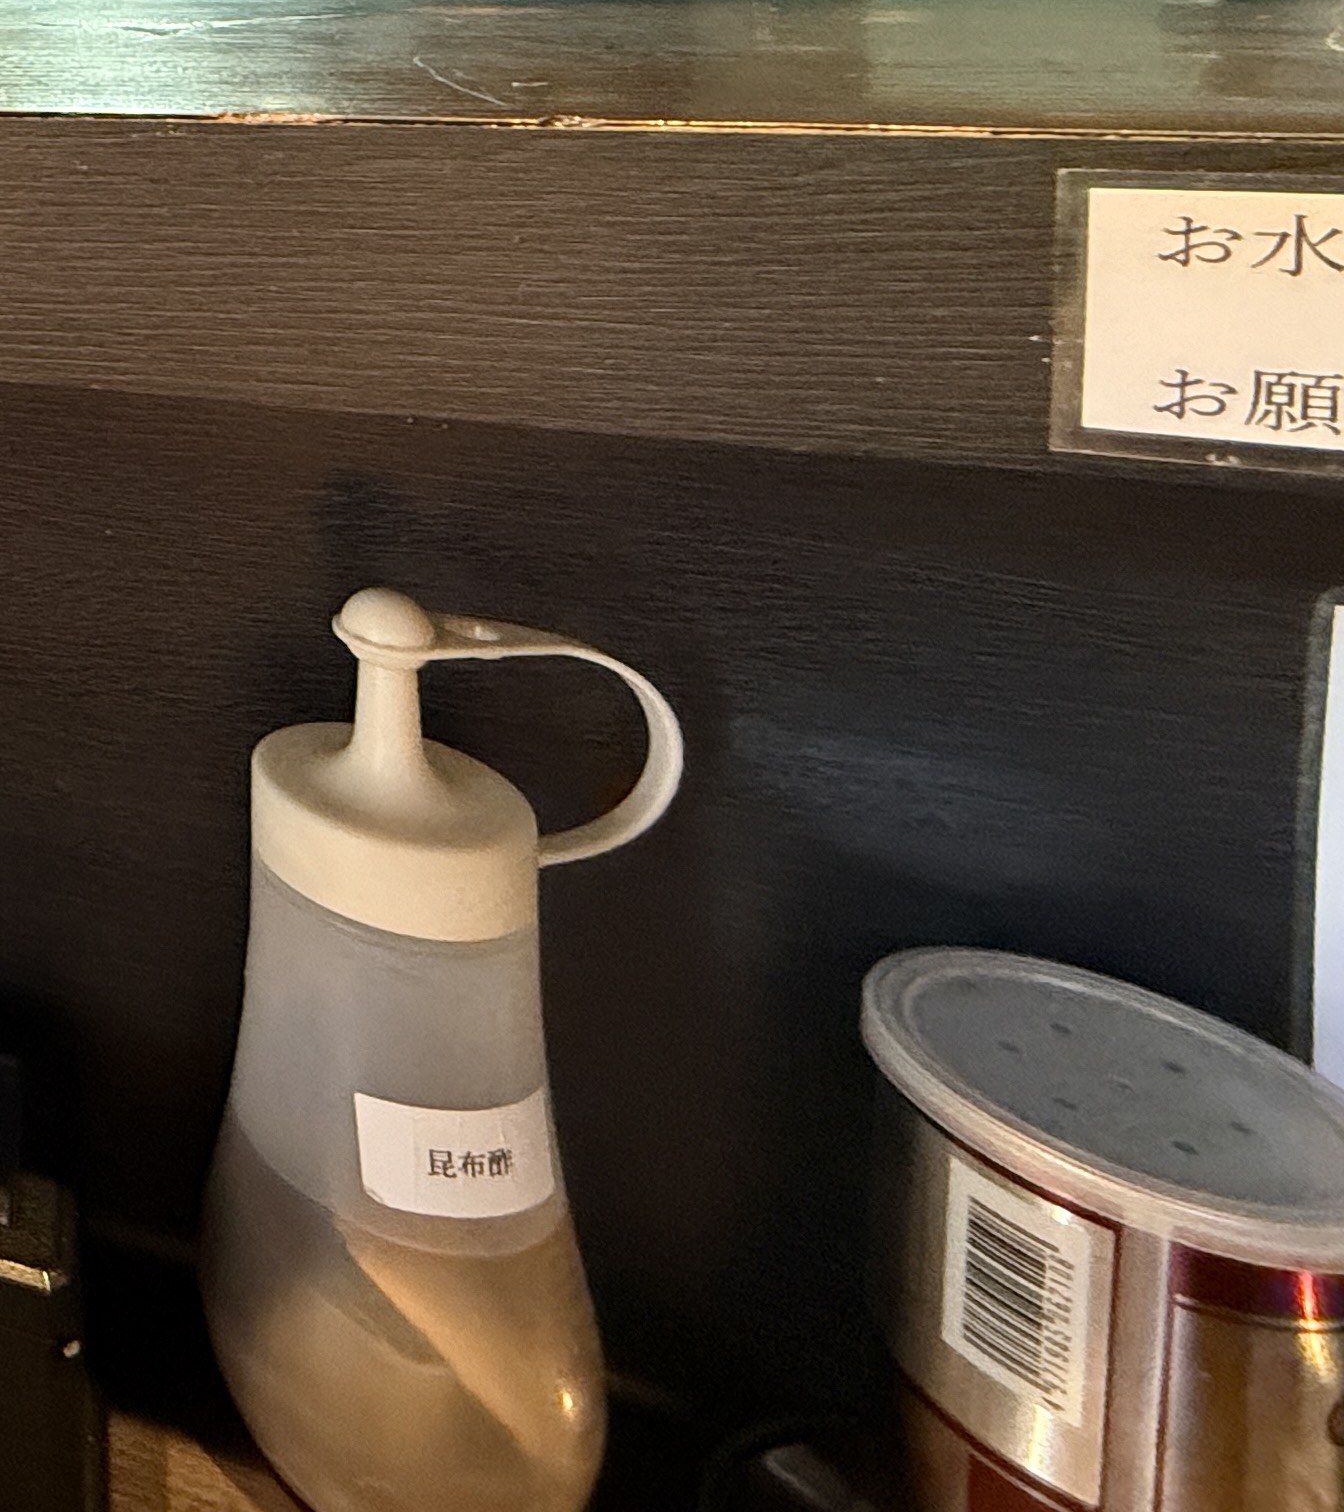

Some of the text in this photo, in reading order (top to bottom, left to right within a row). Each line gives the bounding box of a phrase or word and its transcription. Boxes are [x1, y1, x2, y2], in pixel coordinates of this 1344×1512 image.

[1157, 214, 1344, 276] お水
[1153, 369, 1344, 435] お願
[427, 1148, 513, 1178] 昆布酢
